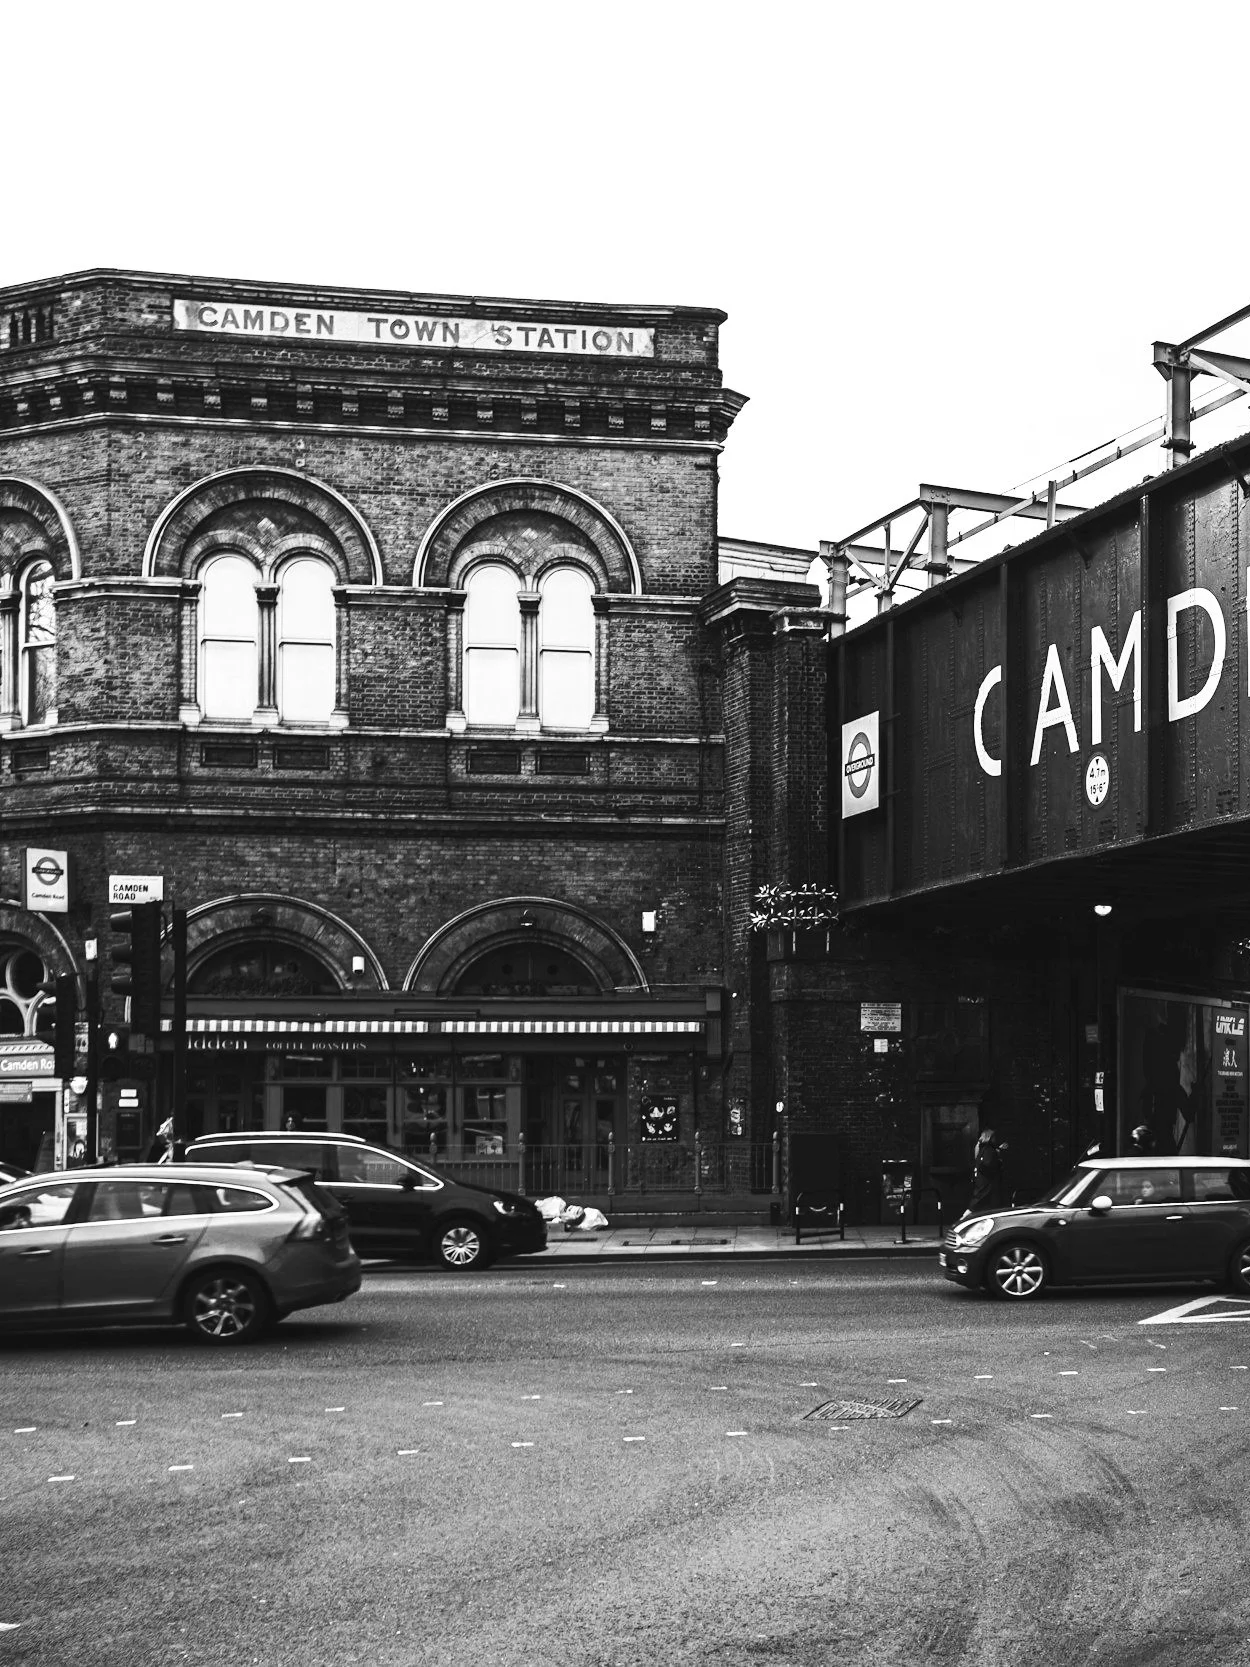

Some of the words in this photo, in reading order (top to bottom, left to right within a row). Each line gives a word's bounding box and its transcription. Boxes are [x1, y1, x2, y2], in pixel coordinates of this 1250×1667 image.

[197, 305, 336, 336] CAMDEN
[367, 316, 461, 343] TOWN
[494, 324, 635, 353] STATION
[846, 757, 873, 773] OVERGROUND
[1090, 768, 1105, 777] 4.7m
[113, 884, 149, 892] CAMDEN
[113, 892, 136, 901] ROAD
[0, 1058, 38, 1072] Camden
